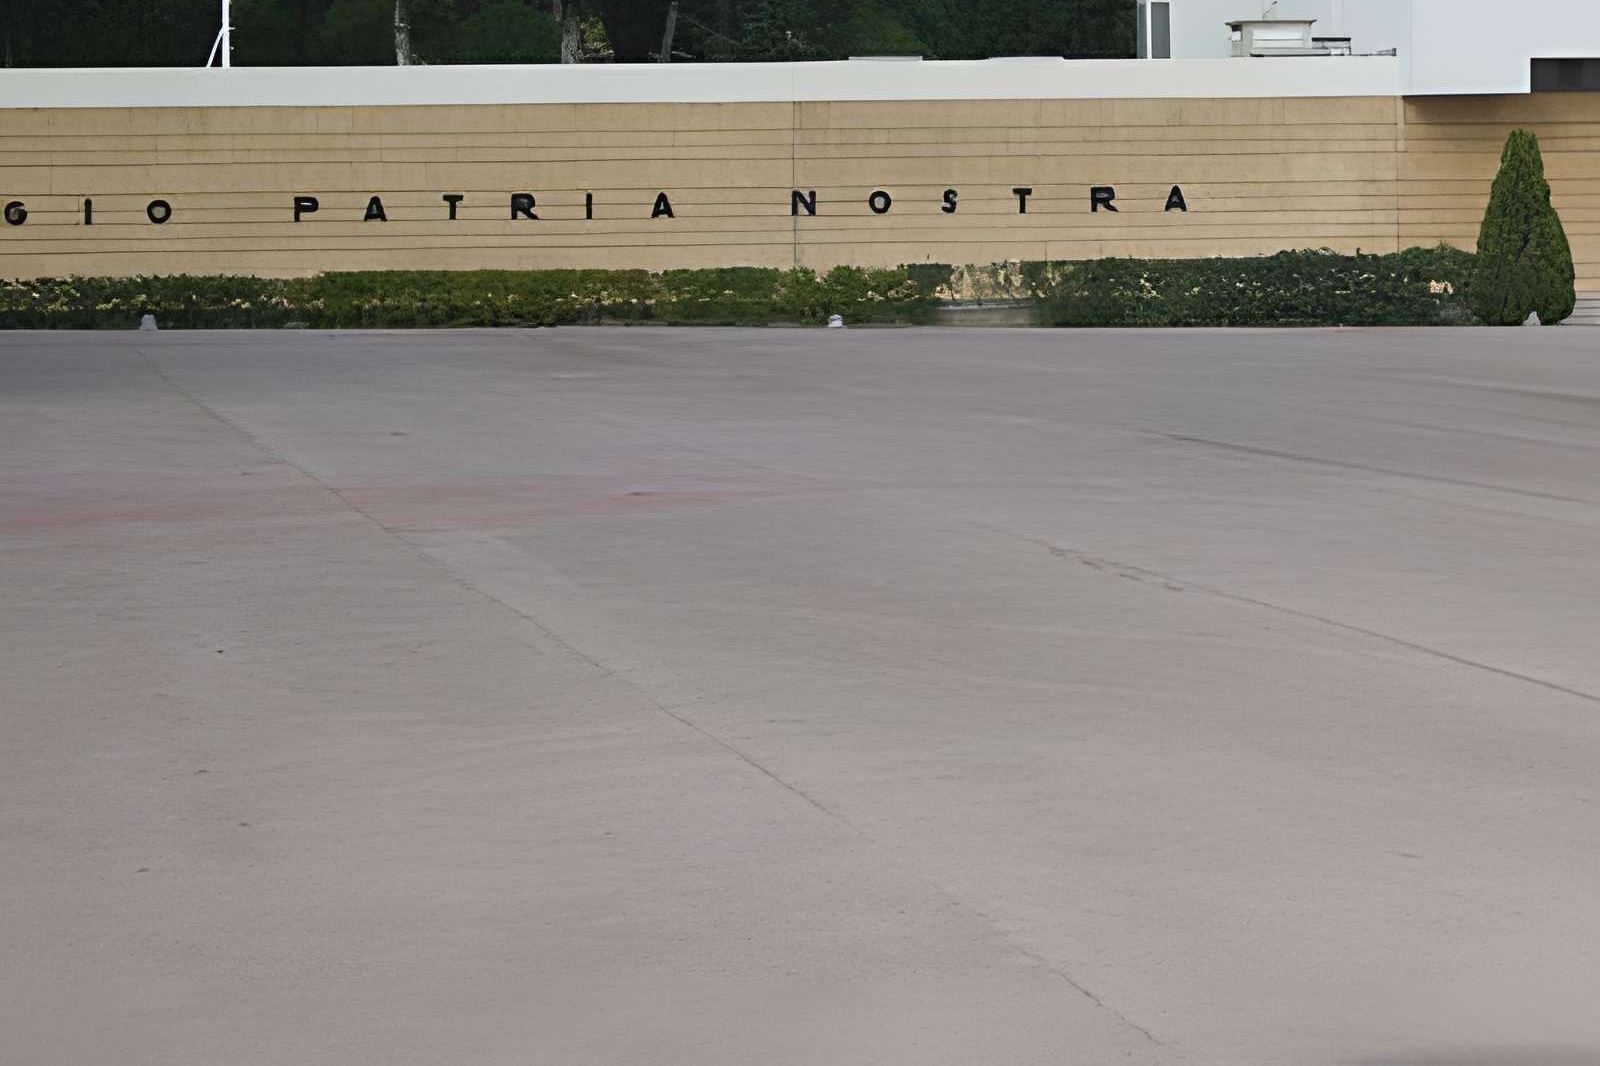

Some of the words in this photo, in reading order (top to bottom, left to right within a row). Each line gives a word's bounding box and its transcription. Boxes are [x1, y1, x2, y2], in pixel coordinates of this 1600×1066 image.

[3, 198, 173, 227] GIO
[292, 191, 676, 223] PATRIA
[790, 185, 1189, 217] NOSTRA
